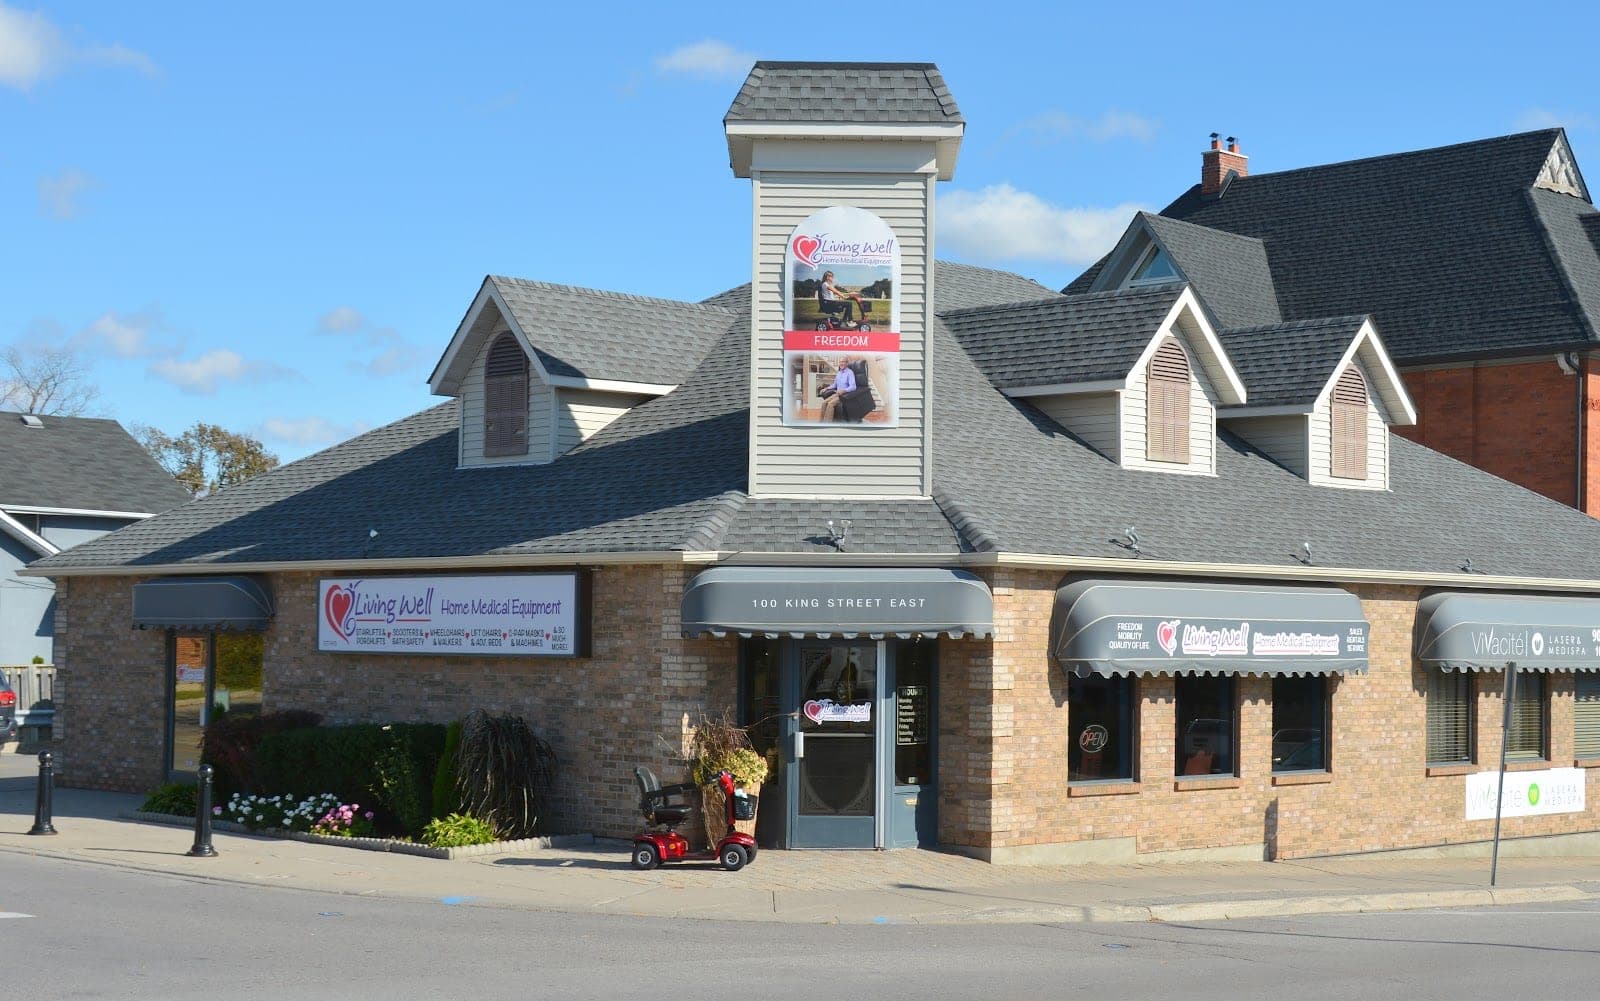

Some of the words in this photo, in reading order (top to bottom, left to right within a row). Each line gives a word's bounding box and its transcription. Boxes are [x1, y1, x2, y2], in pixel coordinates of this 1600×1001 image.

[822, 240, 859, 257] Living
[863, 239, 894, 254] Well
[814, 335, 868, 346] FREEDOM
[355, 593, 397, 624] Living
[400, 587, 434, 615] Well
[441, 600, 469, 615] Home
[471, 598, 510, 615] Medical
[512, 599, 562, 619] Equipment
[752, 599, 777, 608] 100
[785, 599, 819, 608] KING
[827, 599, 882, 608] STREET
[890, 599, 926, 608] EAST
[1117, 623, 1143, 631] FREEDOM
[470, 629, 482, 637] LIFT
[482, 629, 502, 637] CHAIRS
[1117, 632, 1142, 640] MOBILITY
[1183, 625, 1218, 654] Living
[1218, 623, 1249, 648] Well
[1549, 635, 1575, 644] LASER
[1109, 641, 1131, 649] QUALITY
[1139, 641, 1150, 650] LIFE
[1548, 646, 1586, 656] MEDISPA
[1082, 731, 1106, 747] OPEN
